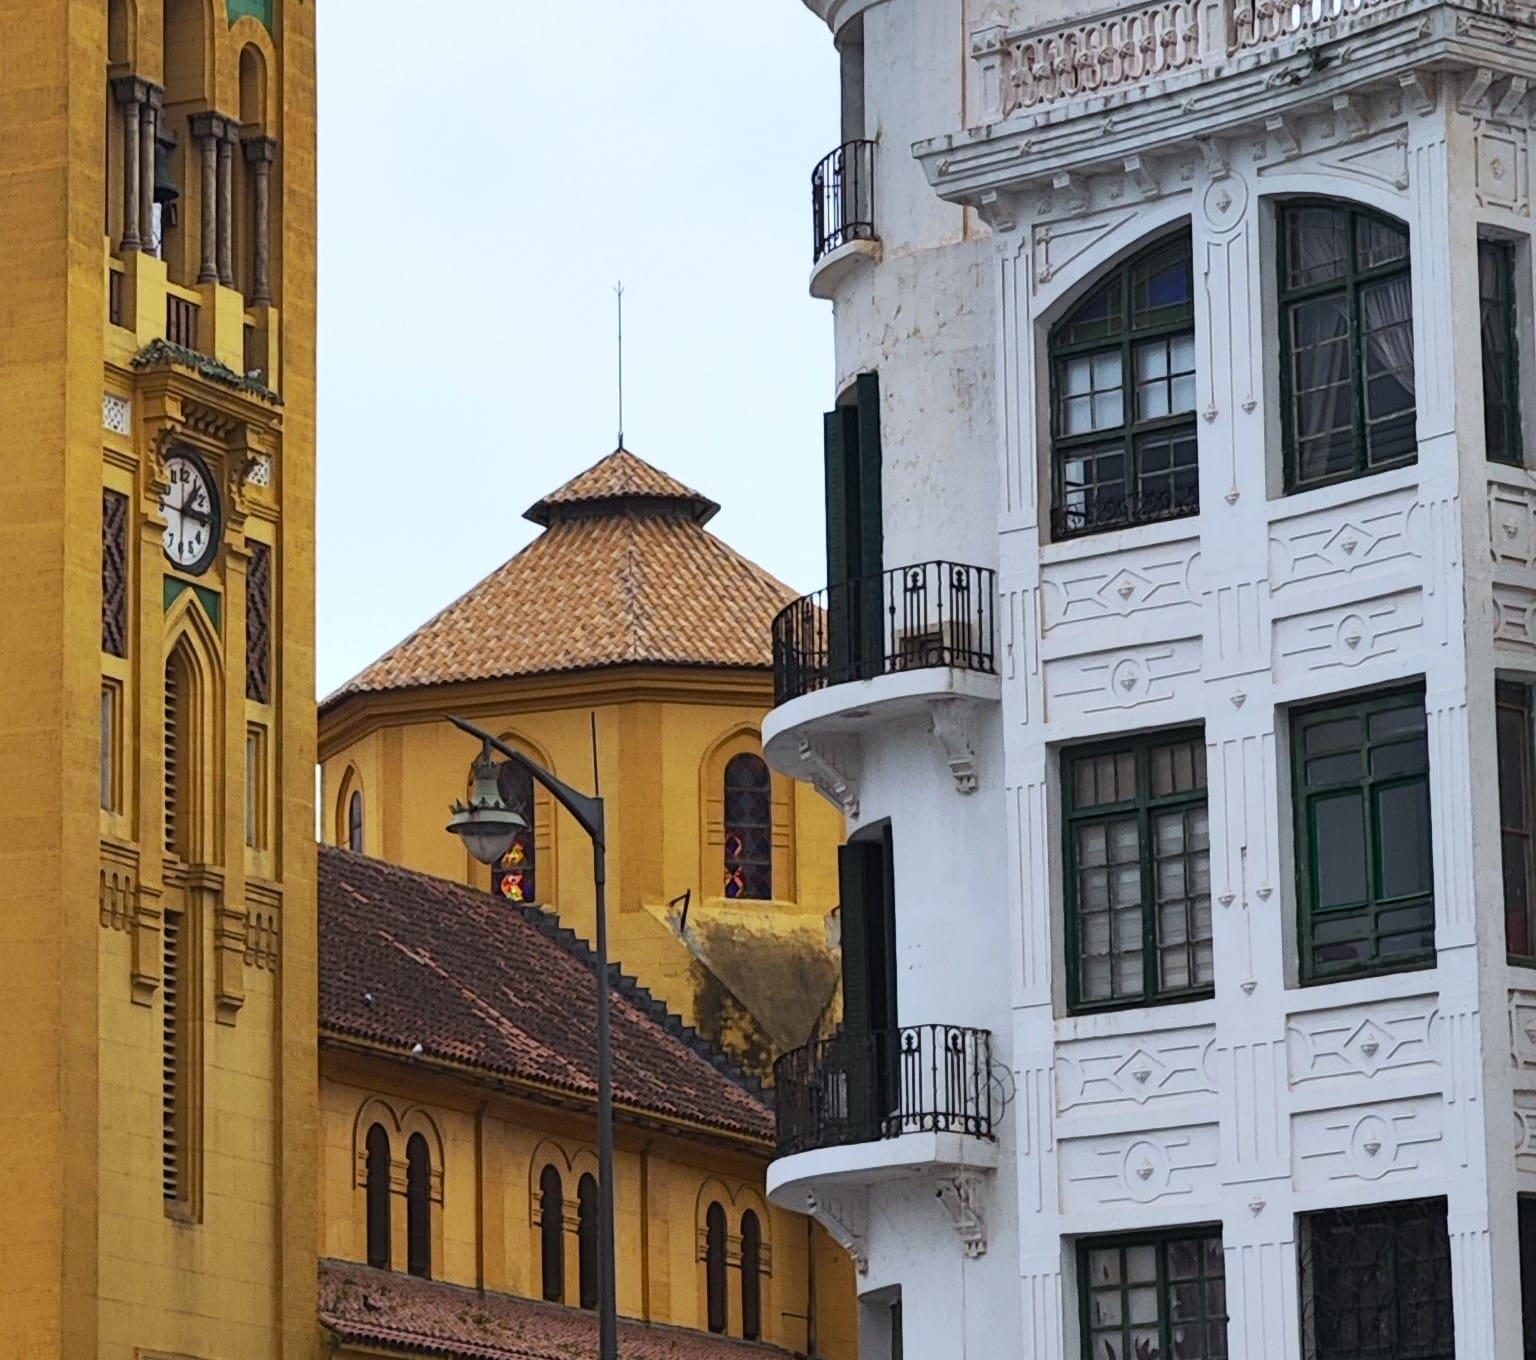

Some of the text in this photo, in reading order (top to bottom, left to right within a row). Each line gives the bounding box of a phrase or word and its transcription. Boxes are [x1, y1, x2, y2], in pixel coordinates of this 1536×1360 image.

[180, 468, 190, 484] 12
[198, 494, 206, 507] 2
[168, 533, 174, 548] 7
[195, 531, 201, 545] 4
[188, 540, 194, 554] 5
